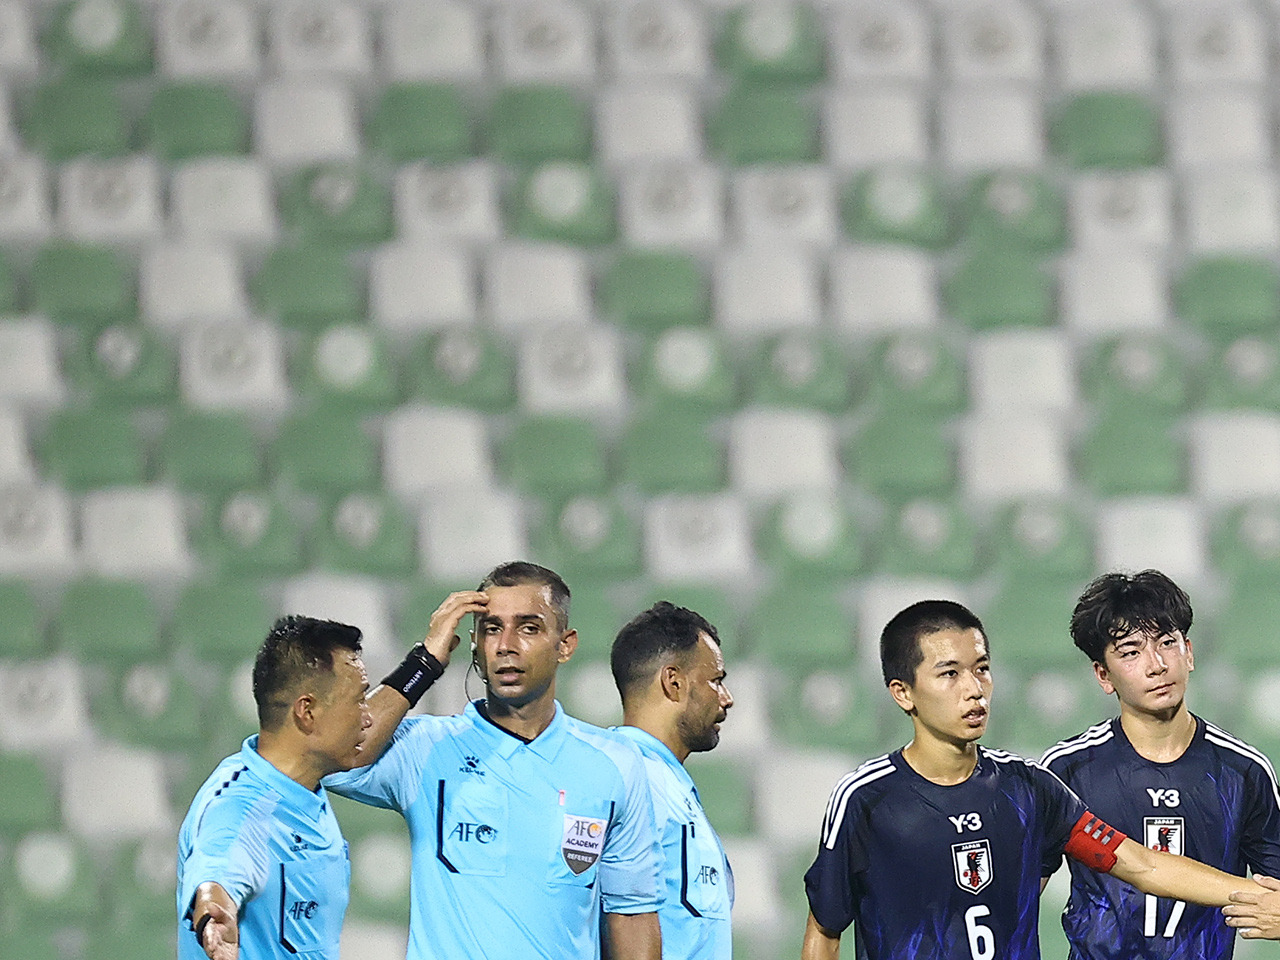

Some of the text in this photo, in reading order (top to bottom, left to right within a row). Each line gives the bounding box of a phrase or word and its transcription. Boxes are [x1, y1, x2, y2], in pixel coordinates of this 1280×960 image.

[1146, 788, 1180, 808] Y-3
[447, 821, 499, 844] AFC
[567, 820, 603, 839] AFC
[948, 812, 983, 834] Y-3
[566, 838, 599, 849] ACADEMY
